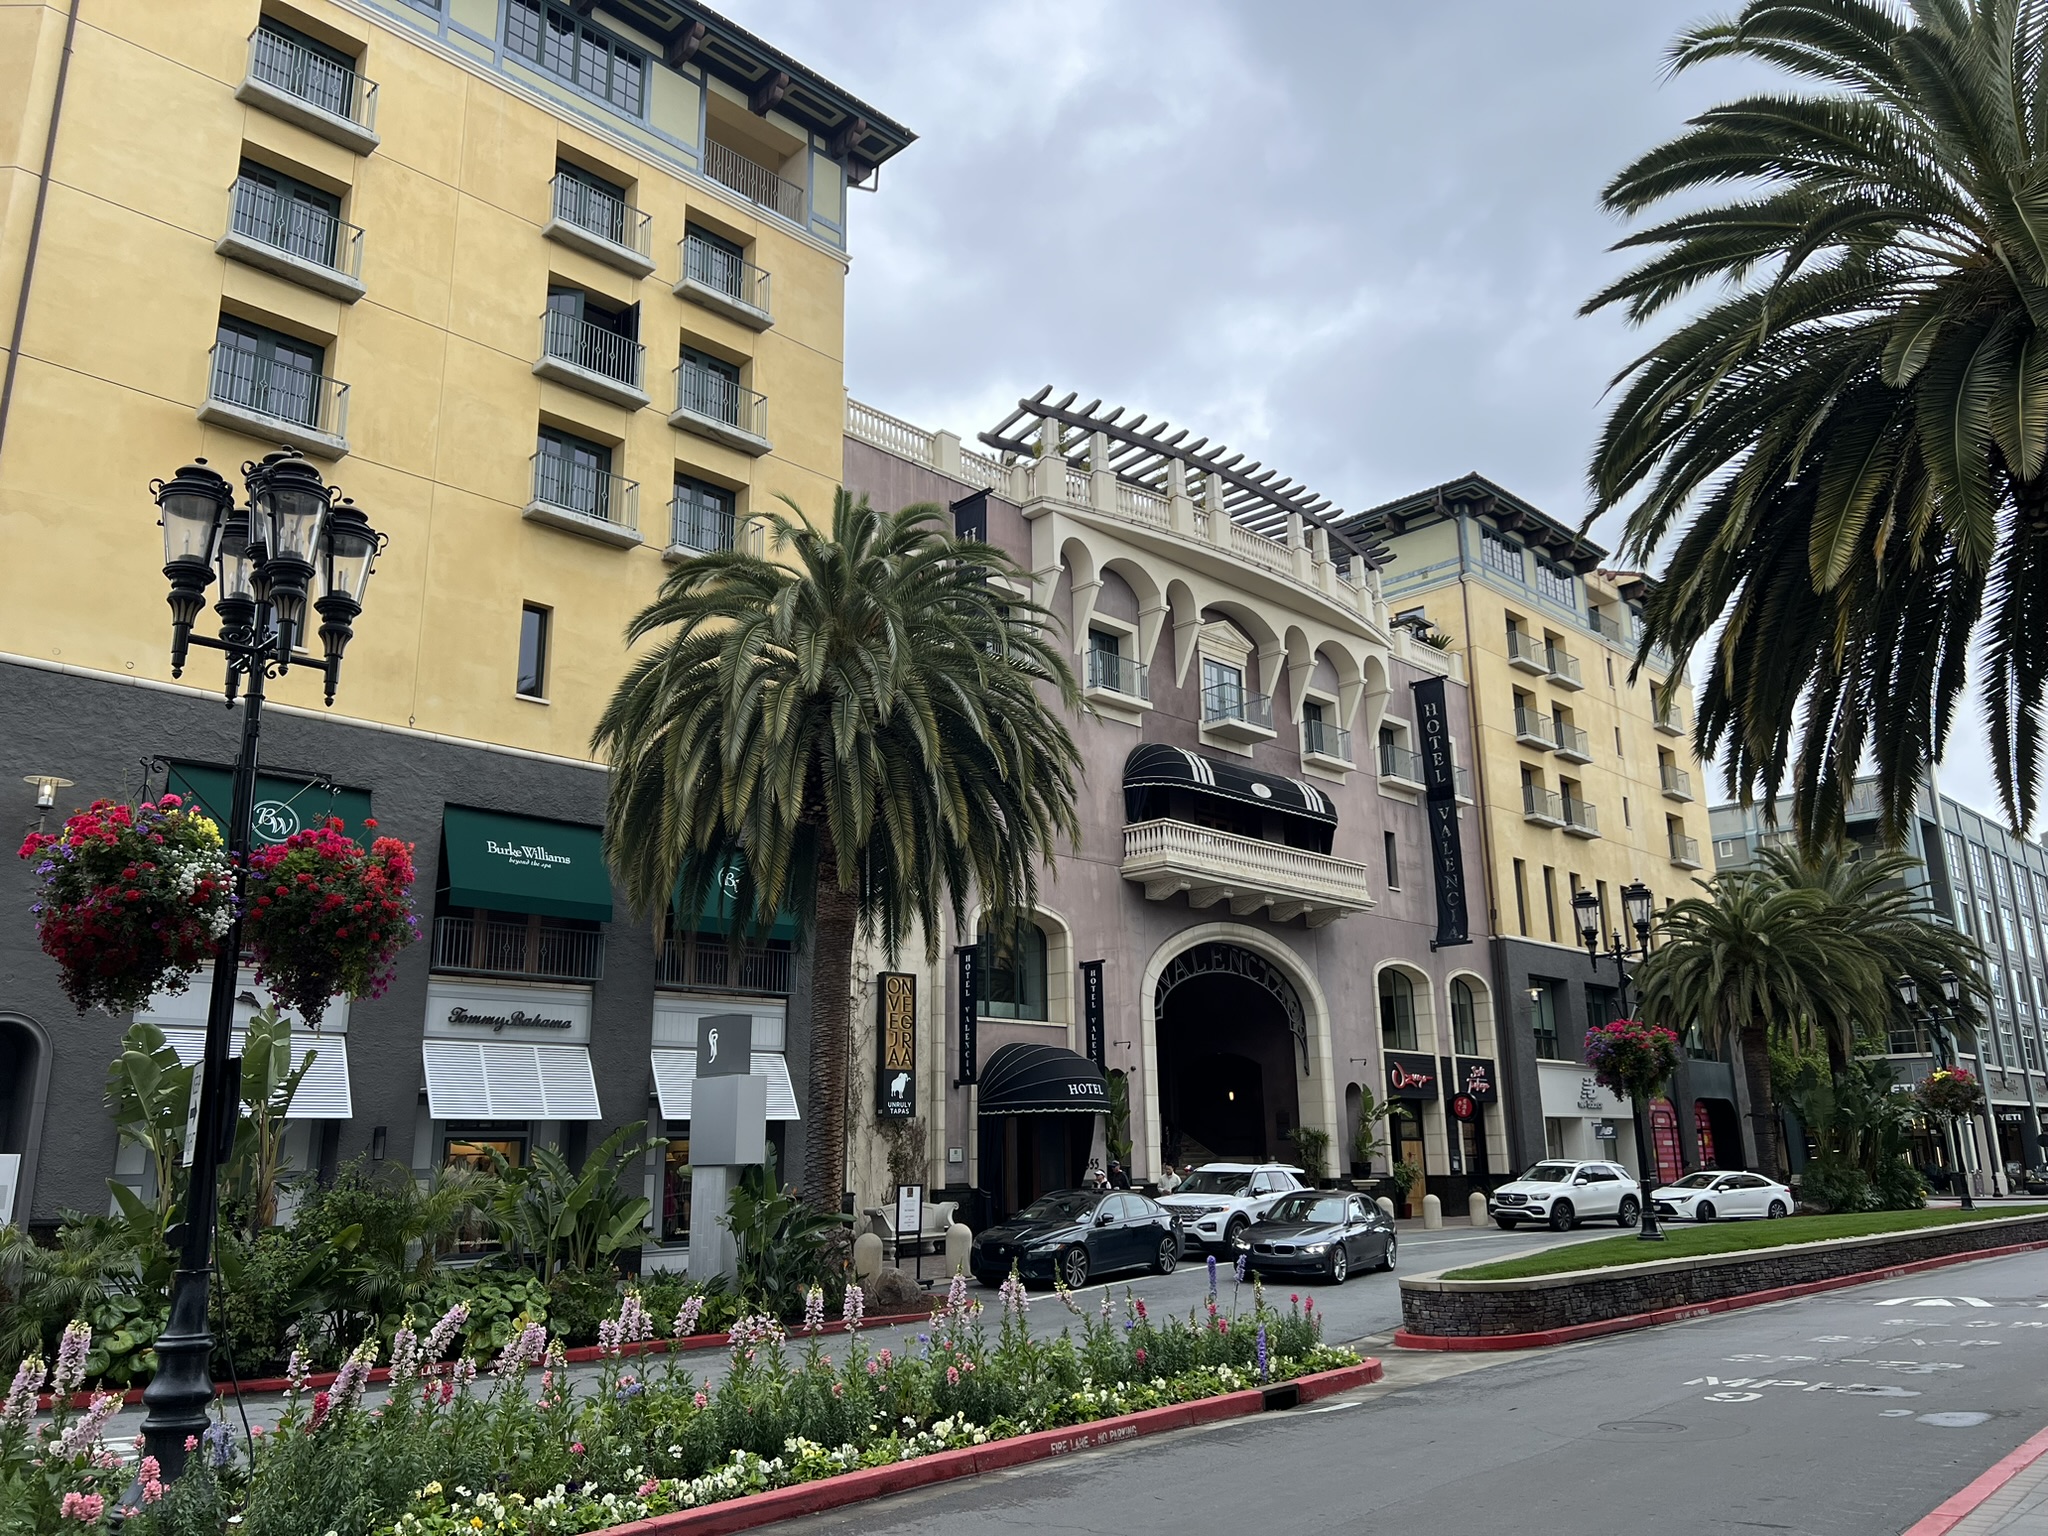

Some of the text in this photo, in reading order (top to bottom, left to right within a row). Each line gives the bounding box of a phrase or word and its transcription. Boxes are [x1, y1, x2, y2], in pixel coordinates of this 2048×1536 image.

[1424, 702, 1460, 939] HOTEL VALENCIA
[486, 840, 571, 864] Burke Williams
[508, 857, 530, 865] beyond
[1158, 944, 1289, 1011] VALENCIA
[448, 1007, 572, 1031] Tommy Bahama
[1068, 1084, 1103, 1095] HOTEL
[1998, 1113, 2021, 1121] YETI
[1050, 1440, 1068, 1455] FIRE
[1070, 1436, 1089, 1451] LANE
[1098, 1432, 1108, 1444] NO
[1109, 1425, 1138, 1441] PARKING
